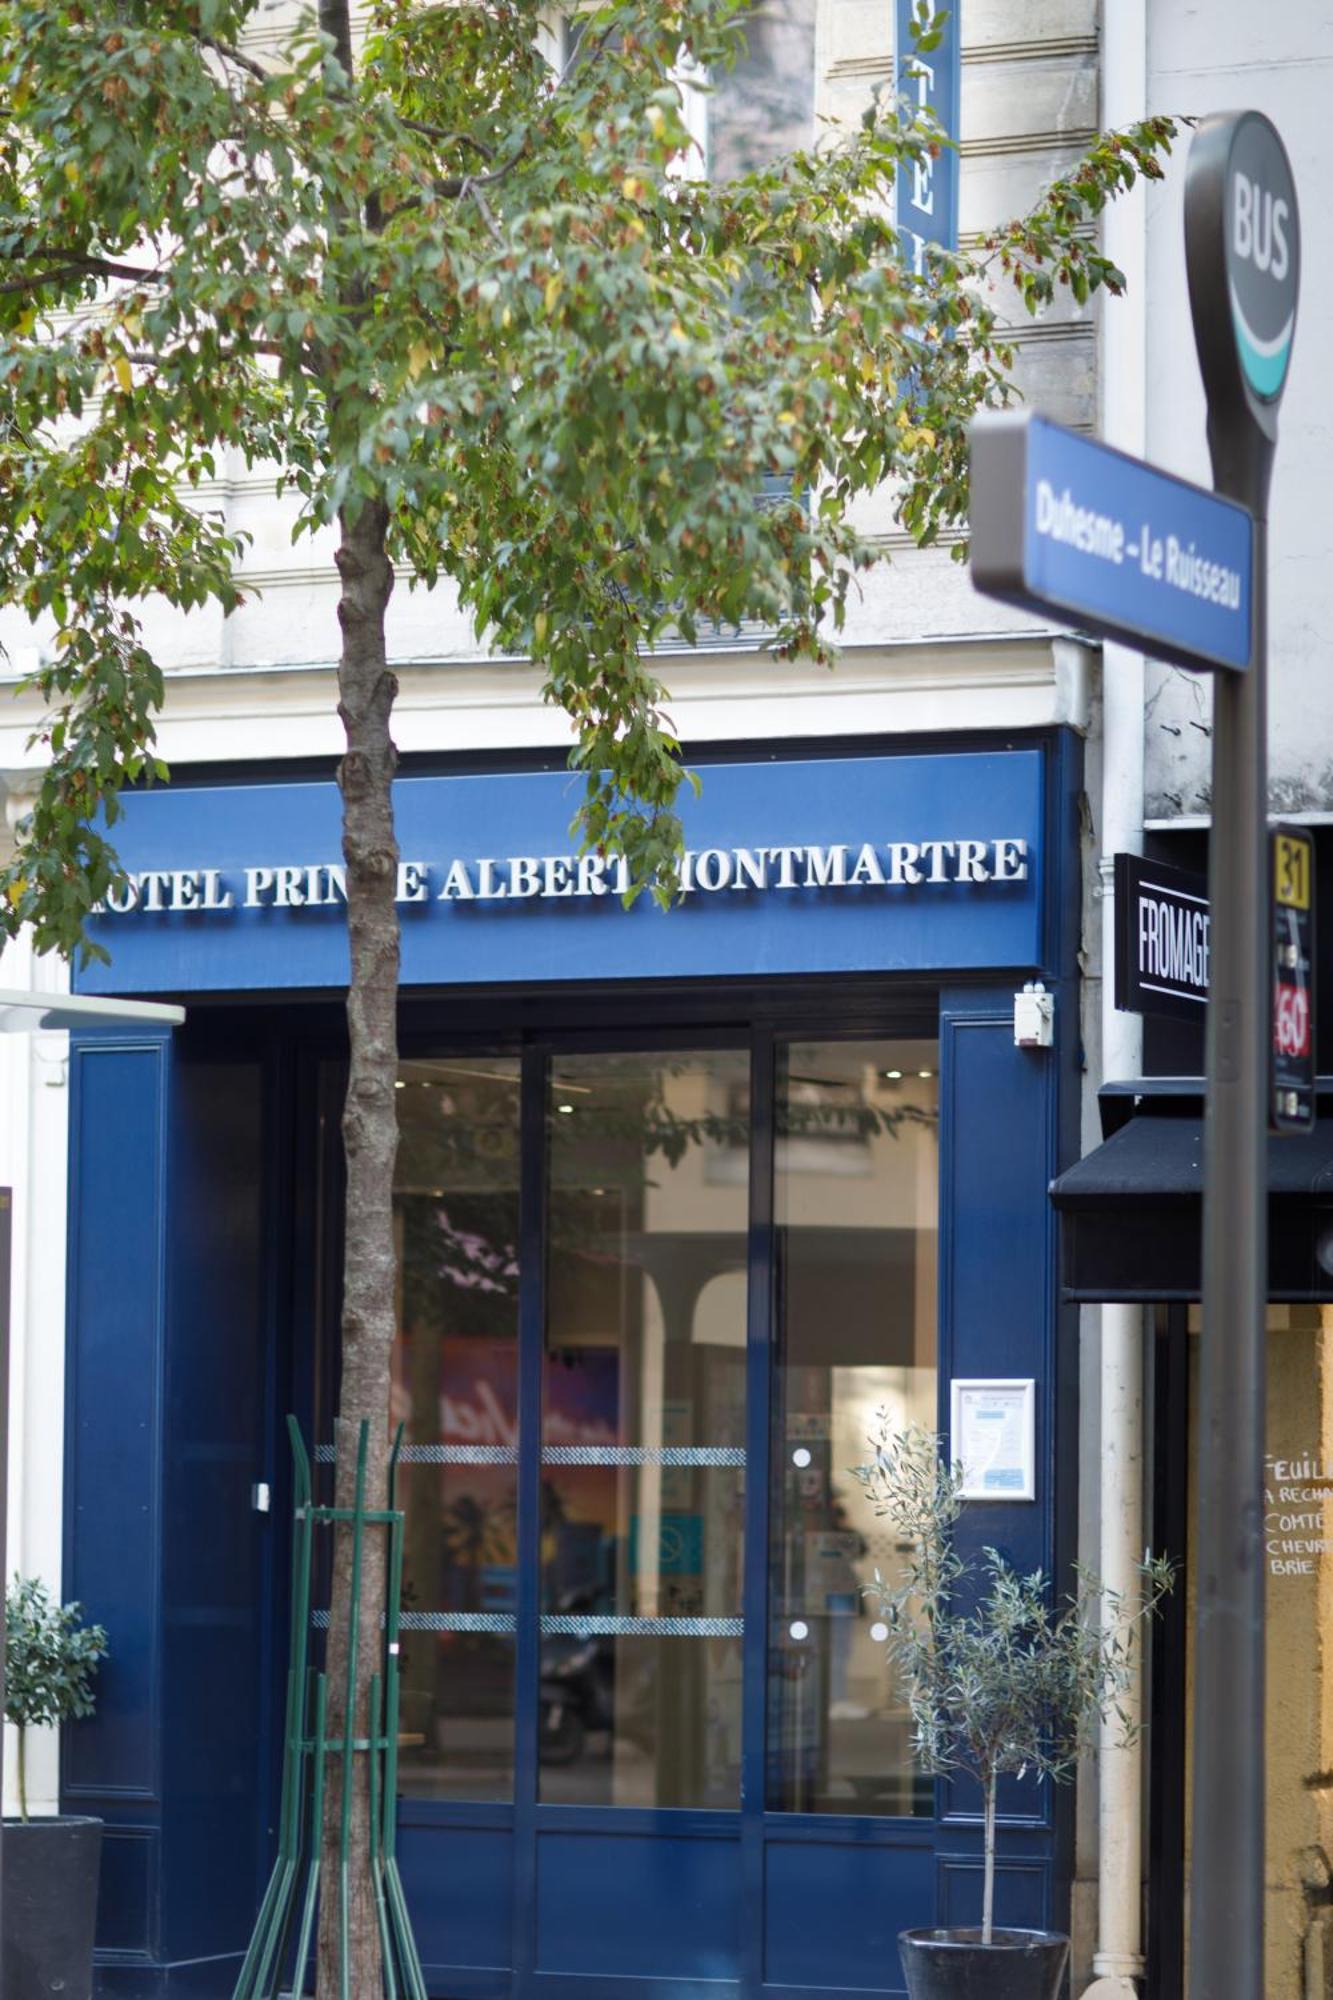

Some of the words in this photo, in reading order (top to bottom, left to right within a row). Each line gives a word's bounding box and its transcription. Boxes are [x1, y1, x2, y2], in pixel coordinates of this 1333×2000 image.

[1233, 171, 1289, 282] BUS
[1036, 480, 1124, 565] Duhesme
[1141, 523, 1164, 580] Le
[1165, 534, 1240, 610] Ruisseau
[90, 868, 232, 914] OTEL
[243, 860, 428, 908] PRINE
[436, 851, 629, 903] ALBERT
